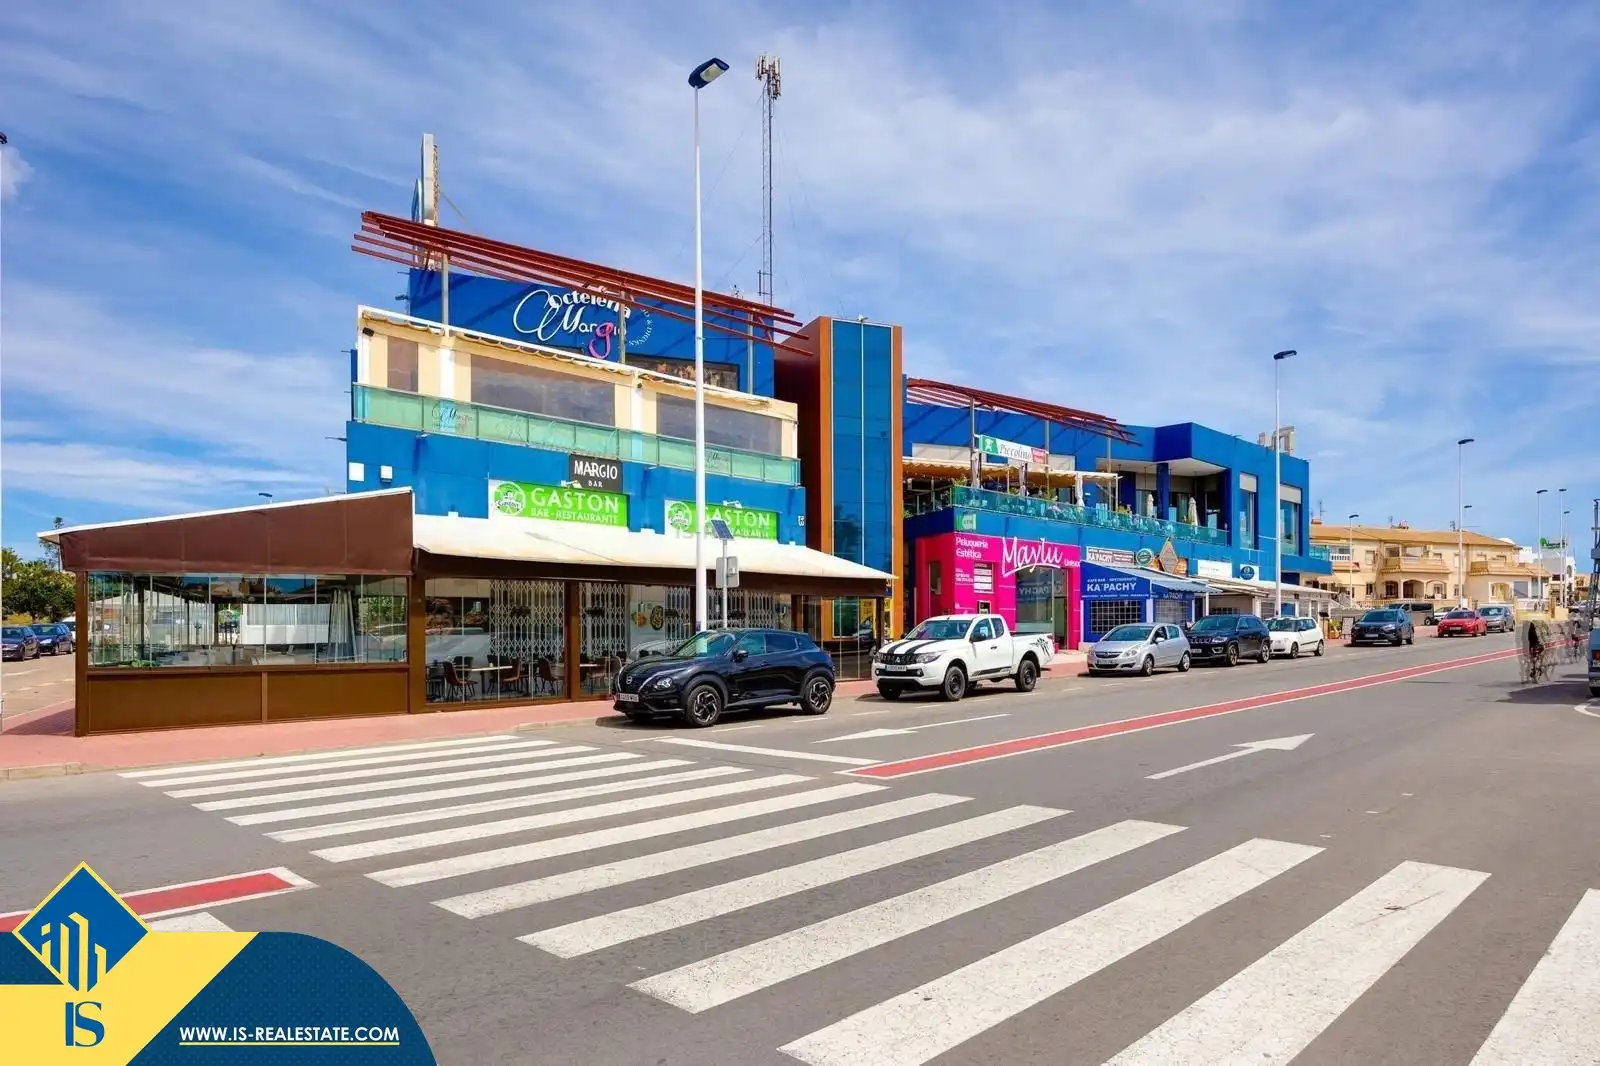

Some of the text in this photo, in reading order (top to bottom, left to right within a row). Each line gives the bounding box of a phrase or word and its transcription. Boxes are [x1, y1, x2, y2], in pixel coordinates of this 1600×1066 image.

[573, 460, 618, 480] MARGIO
[587, 480, 603, 488] BAR
[531, 487, 619, 514] GASTON
[530, 507, 550, 517] BAR
[555, 510, 619, 524] RESTAURANTE
